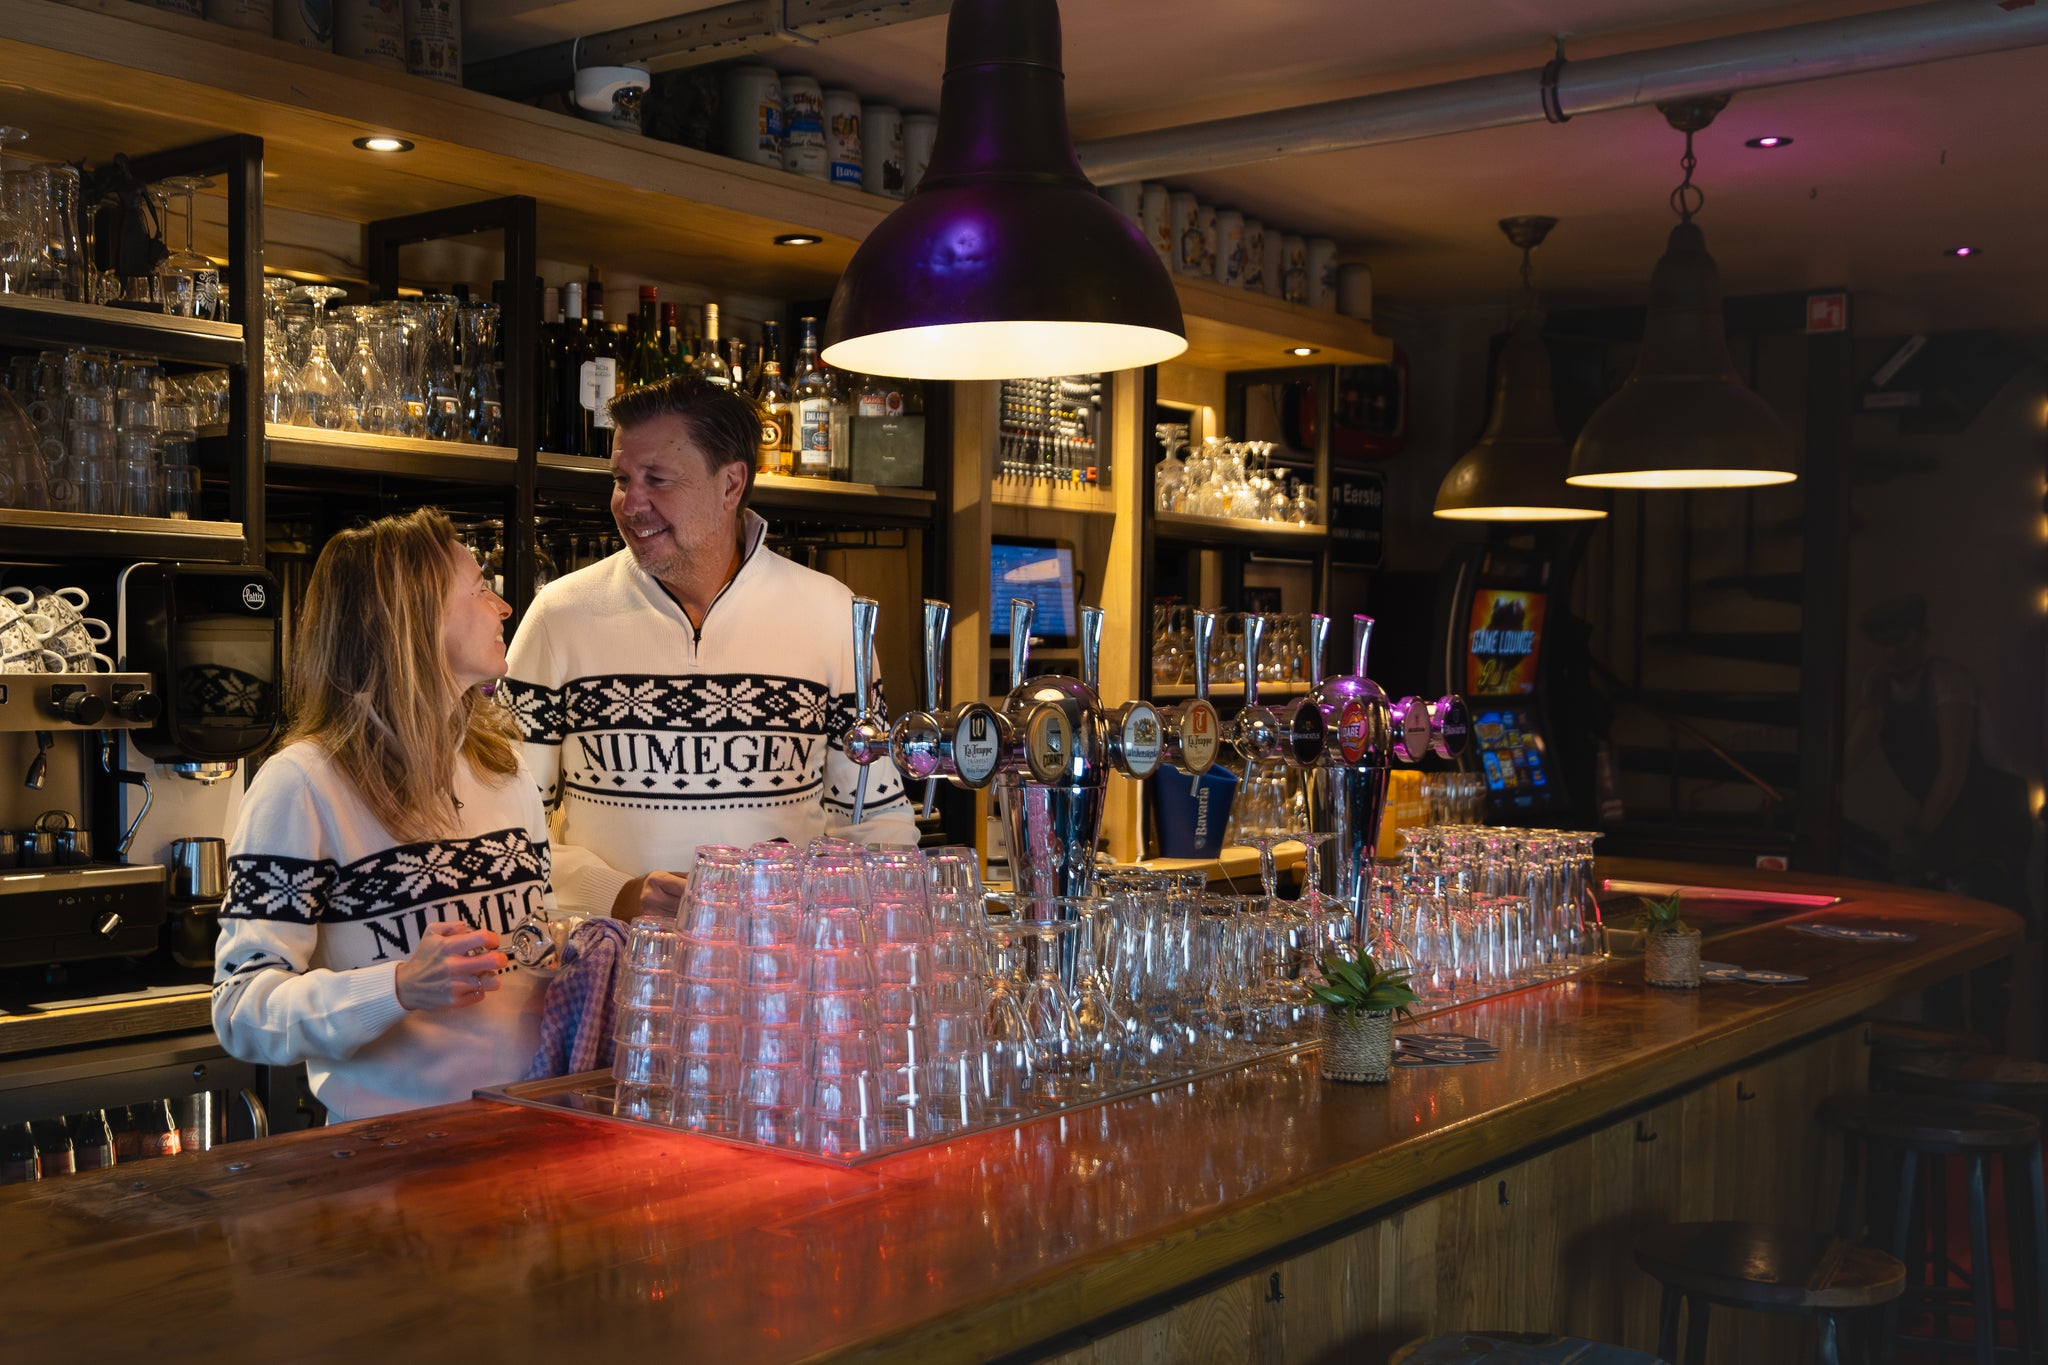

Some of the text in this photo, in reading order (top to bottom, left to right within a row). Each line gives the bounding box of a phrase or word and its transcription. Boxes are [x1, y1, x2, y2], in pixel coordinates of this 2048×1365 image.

[1471, 629, 1536, 655] GAME LOUNGE
[577, 732, 816, 774] NIJMEGEN
[972, 743, 993, 758] Trappe
[1195, 787, 1210, 836] Bavaria
